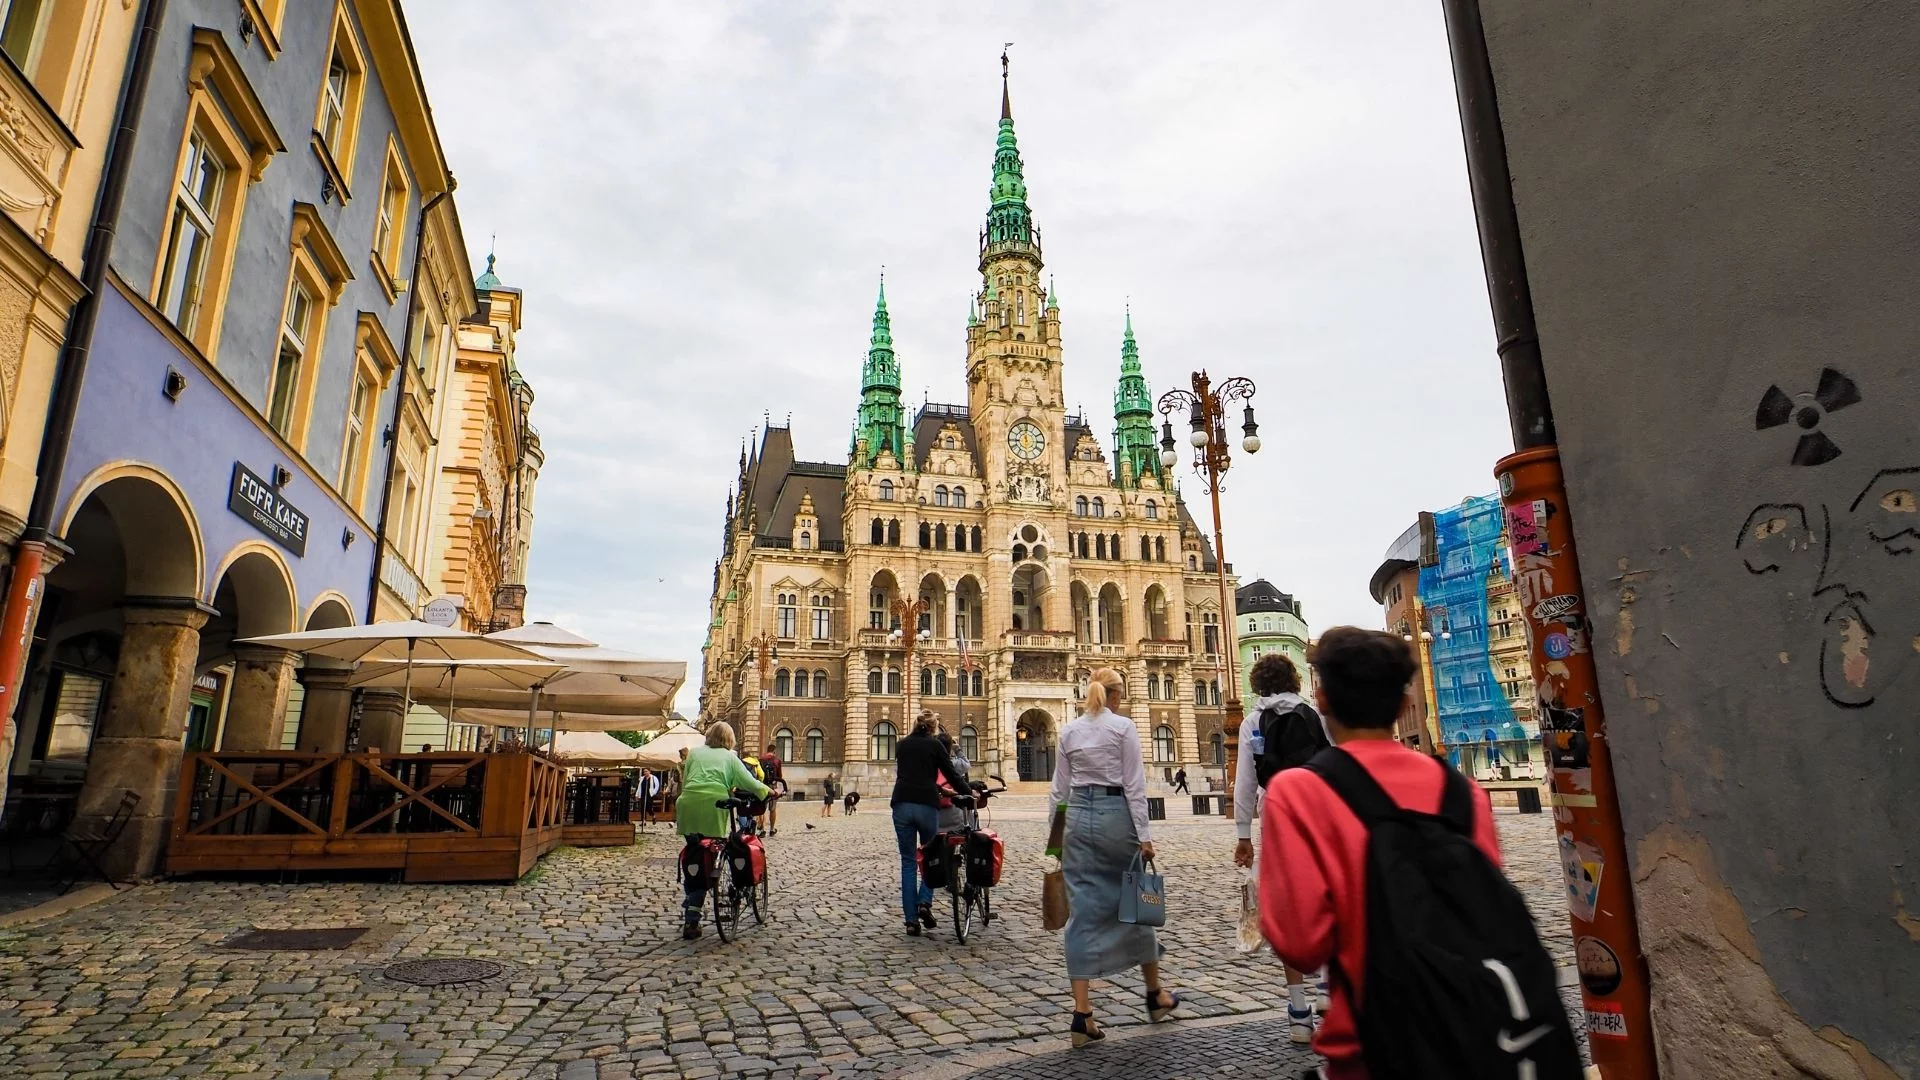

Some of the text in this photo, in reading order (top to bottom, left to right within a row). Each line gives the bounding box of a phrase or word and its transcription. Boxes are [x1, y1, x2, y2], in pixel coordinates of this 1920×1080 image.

[240, 472, 305, 538] FOFR KAFE
[253, 510, 290, 541] ESPRESSO BAR
[1142, 895, 1161, 905] GUESS
